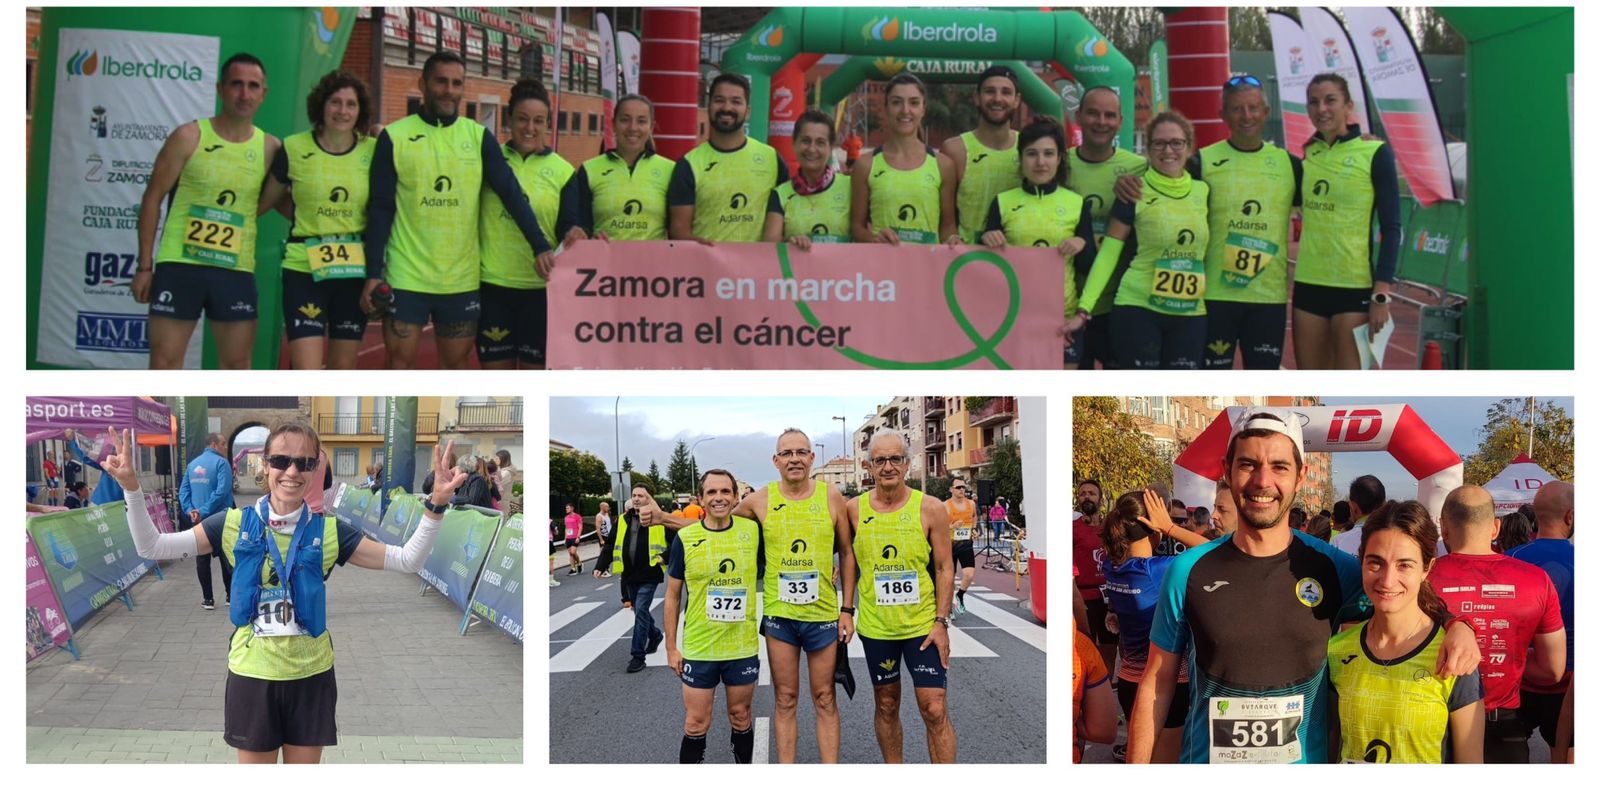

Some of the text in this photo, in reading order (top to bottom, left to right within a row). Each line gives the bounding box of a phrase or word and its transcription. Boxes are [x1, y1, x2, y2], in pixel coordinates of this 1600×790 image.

[903, 21, 997, 43] Iberdrola
[102, 55, 203, 82] Iberdrola
[906, 60, 943, 73] CAJA
[124, 130, 168, 141] ZAMORA
[420, 196, 460, 207] Adarsa
[316, 206, 354, 218] Adarsa
[719, 213, 754, 224] Adarsa
[82, 216, 112, 229] CAJA
[610, 219, 648, 230] Adarsa
[1228, 219, 1268, 231] Adarsa
[188, 220, 234, 248] 222
[319, 244, 350, 263] 34
[1235, 249, 1262, 273] 81
[84, 252, 139, 286] gaz
[575, 268, 896, 302] Zamora en marcha
[1155, 271, 1199, 296] 203
[78, 316, 148, 342] MMT
[574, 316, 852, 347] contra el cáncer
[781, 557, 814, 567] Adarsa
[873, 562, 905, 572] Adarsa
[709, 576, 743, 587] Adarsa
[788, 581, 809, 594] 33
[881, 581, 914, 595] 186
[712, 597, 742, 611] 372
[1231, 719, 1284, 747] 581
